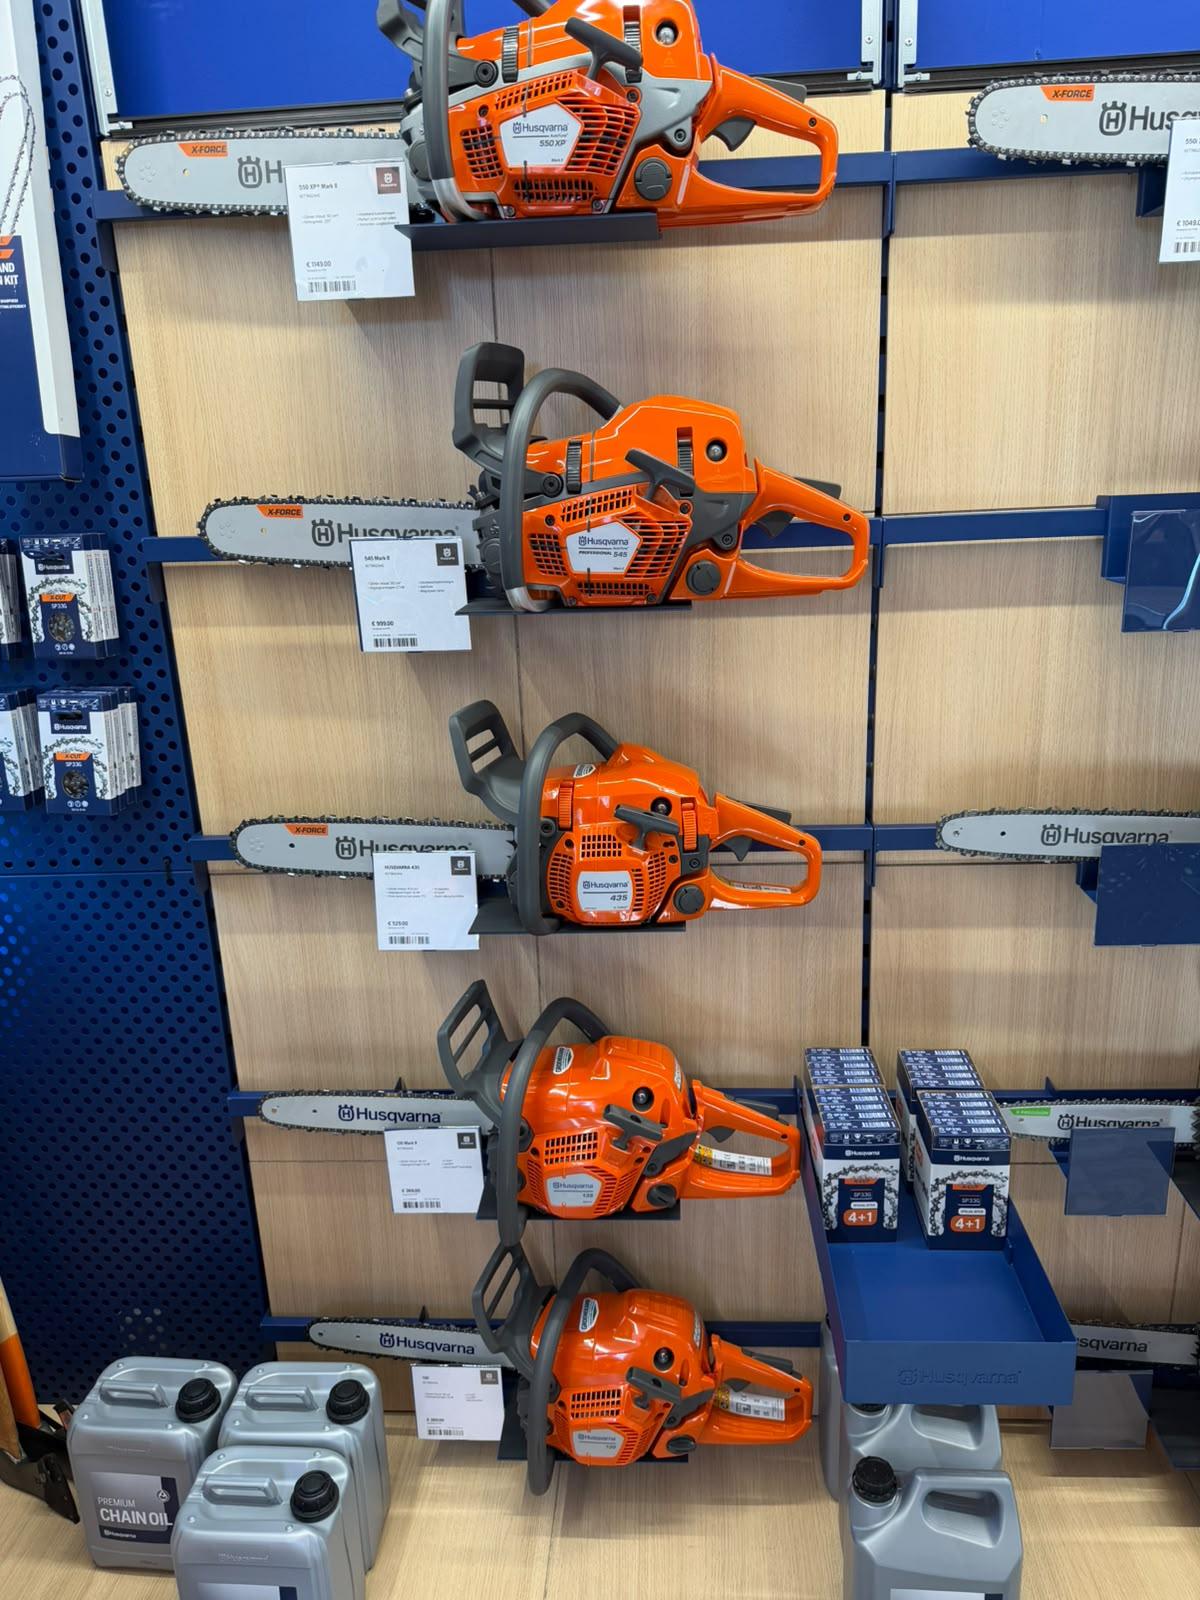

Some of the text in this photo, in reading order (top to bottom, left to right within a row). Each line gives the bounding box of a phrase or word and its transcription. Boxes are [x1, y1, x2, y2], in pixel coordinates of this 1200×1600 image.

[1052, 90, 1091, 98] X-FORCE
[523, 124, 568, 134] Husqvarna
[192, 146, 227, 154] X-FORCE
[4, 275, 18, 285] KIT
[587, 537, 628, 546] Husqvarna
[356, 1107, 441, 1124] Husqvarna
[848, 1212, 872, 1222] 4+1
[955, 1218, 980, 1229] 4+1
[396, 1336, 475, 1355] Husqvarna
[920, 1369, 1019, 1386] Husqvarna
[97, 1496, 136, 1507] PREMIUM
[99, 1508, 173, 1526] CHAIN OIL
